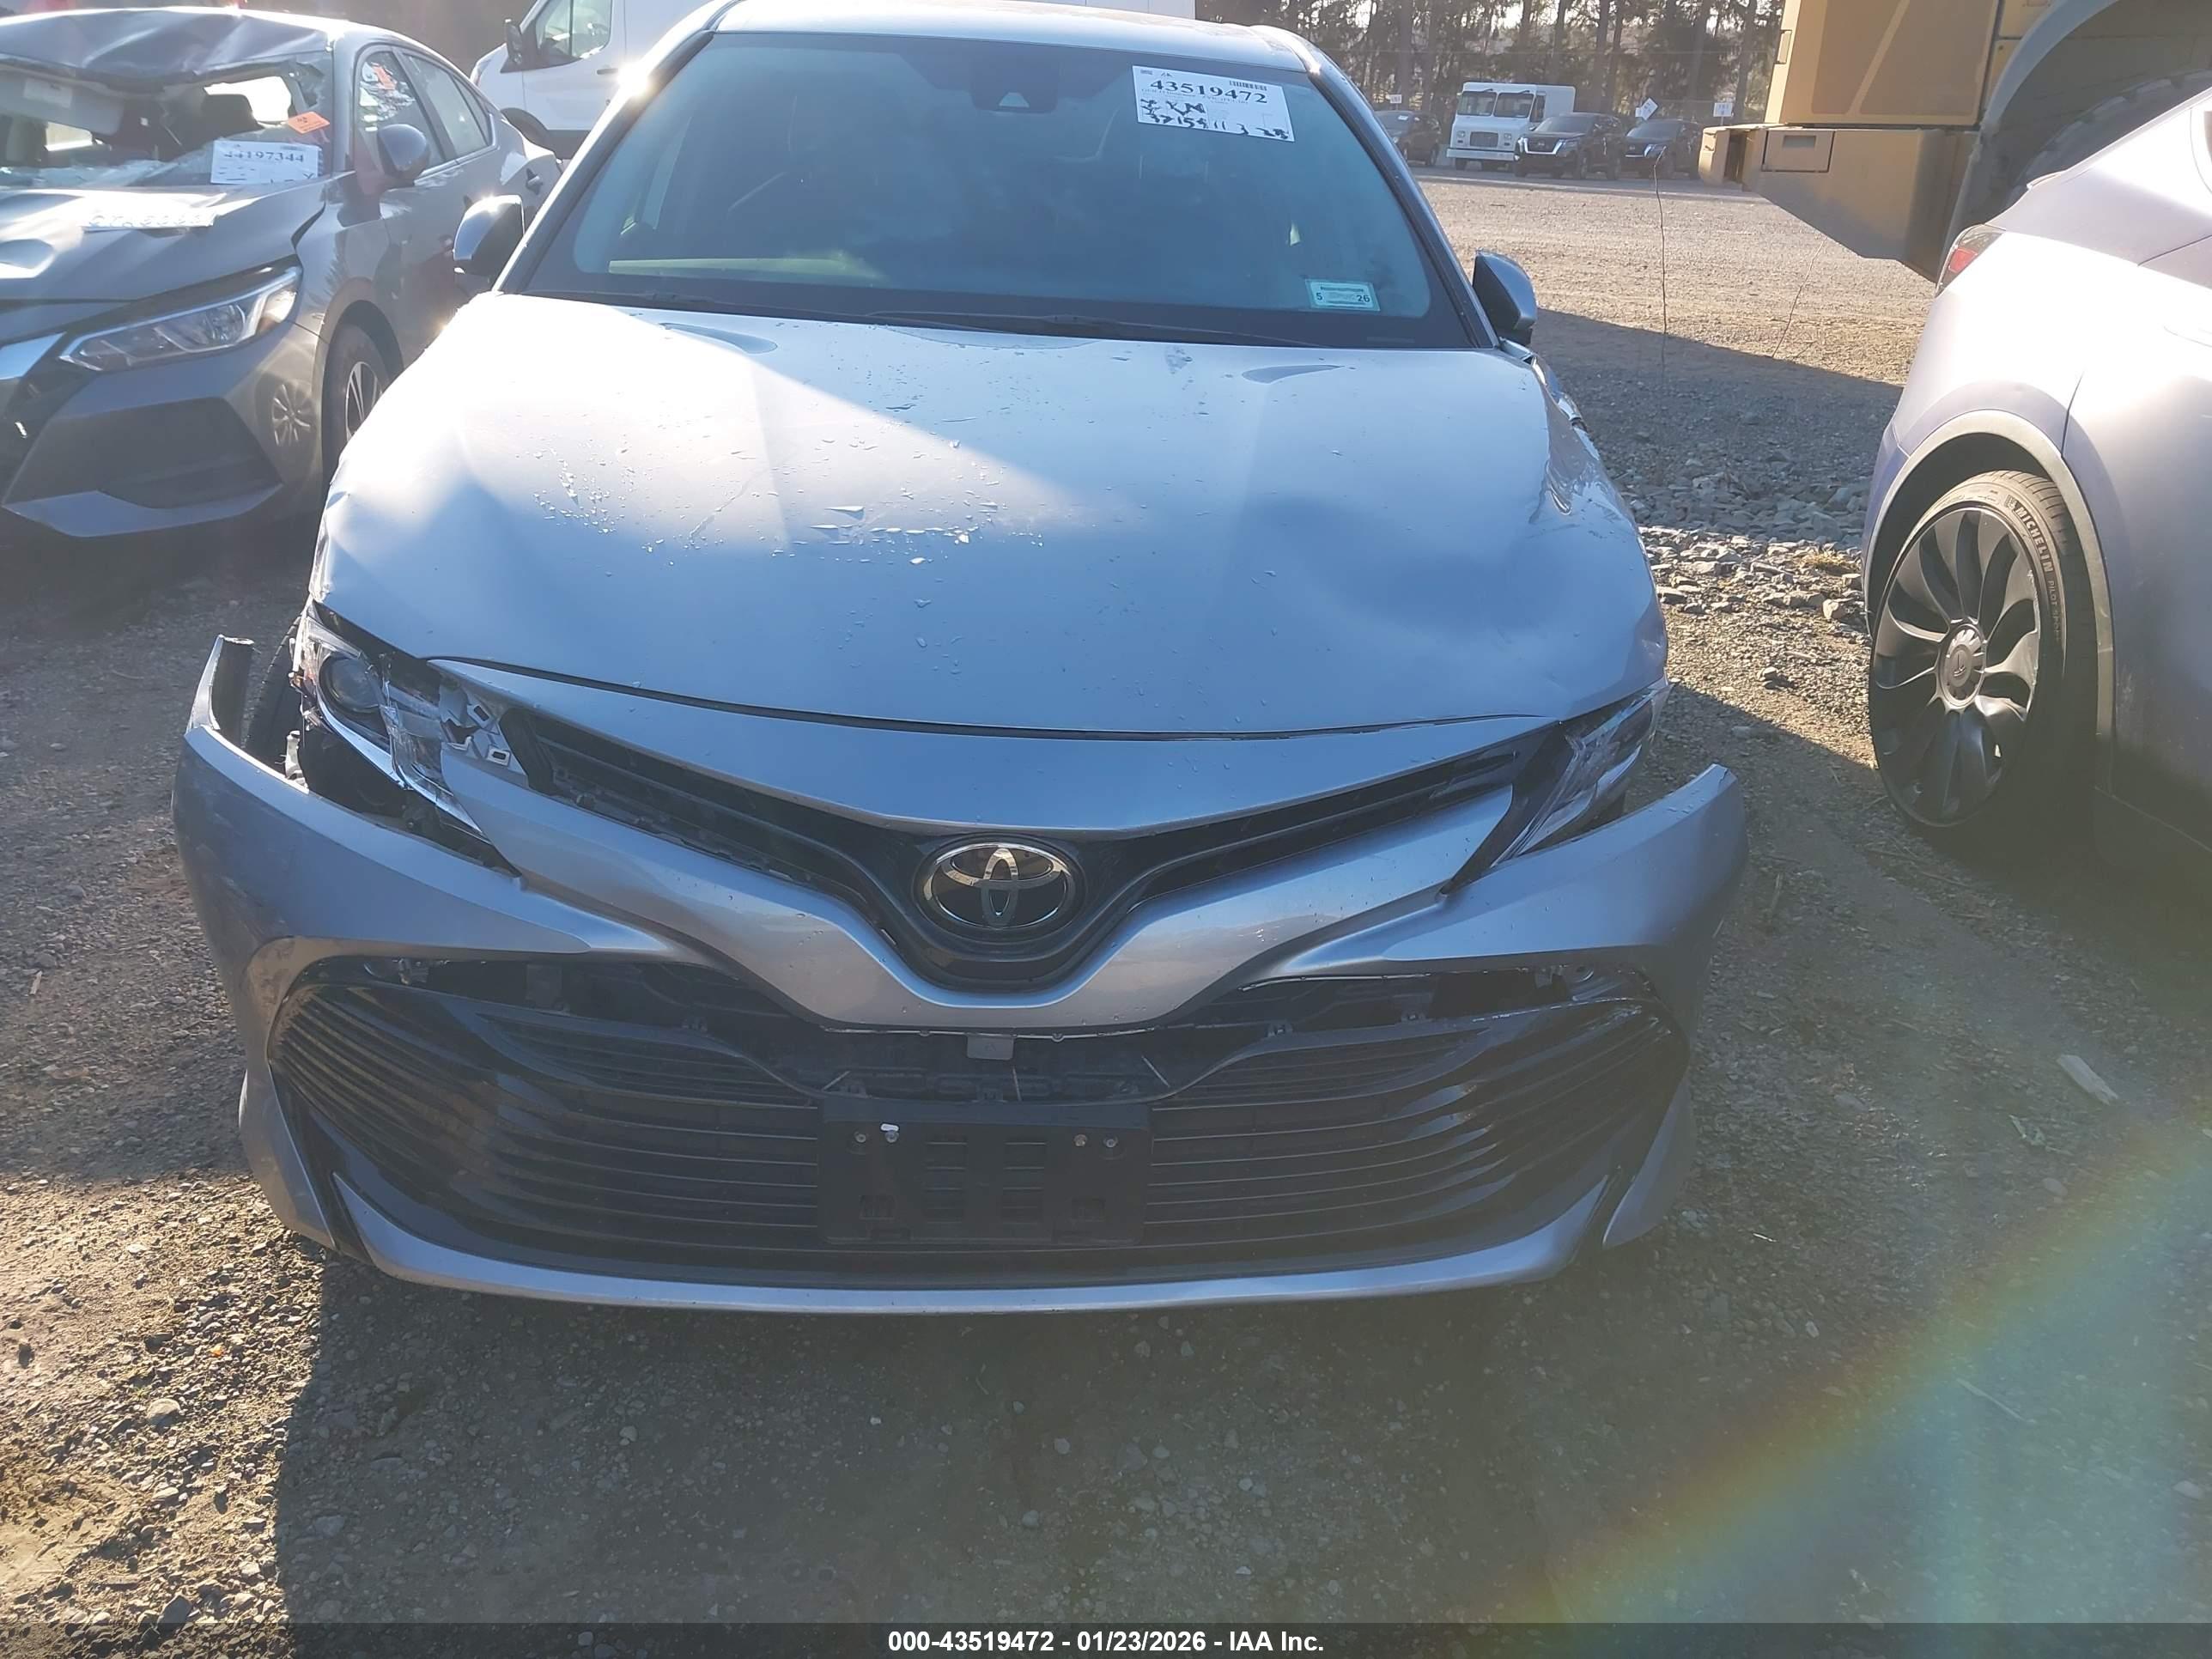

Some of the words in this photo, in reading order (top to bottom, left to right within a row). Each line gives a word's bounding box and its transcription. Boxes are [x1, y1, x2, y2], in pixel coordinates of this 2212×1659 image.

[1150, 80, 1267, 103] 43519472
[2014, 505, 2054, 573] MICHELIN
[2047, 580, 2057, 606] PILOT
